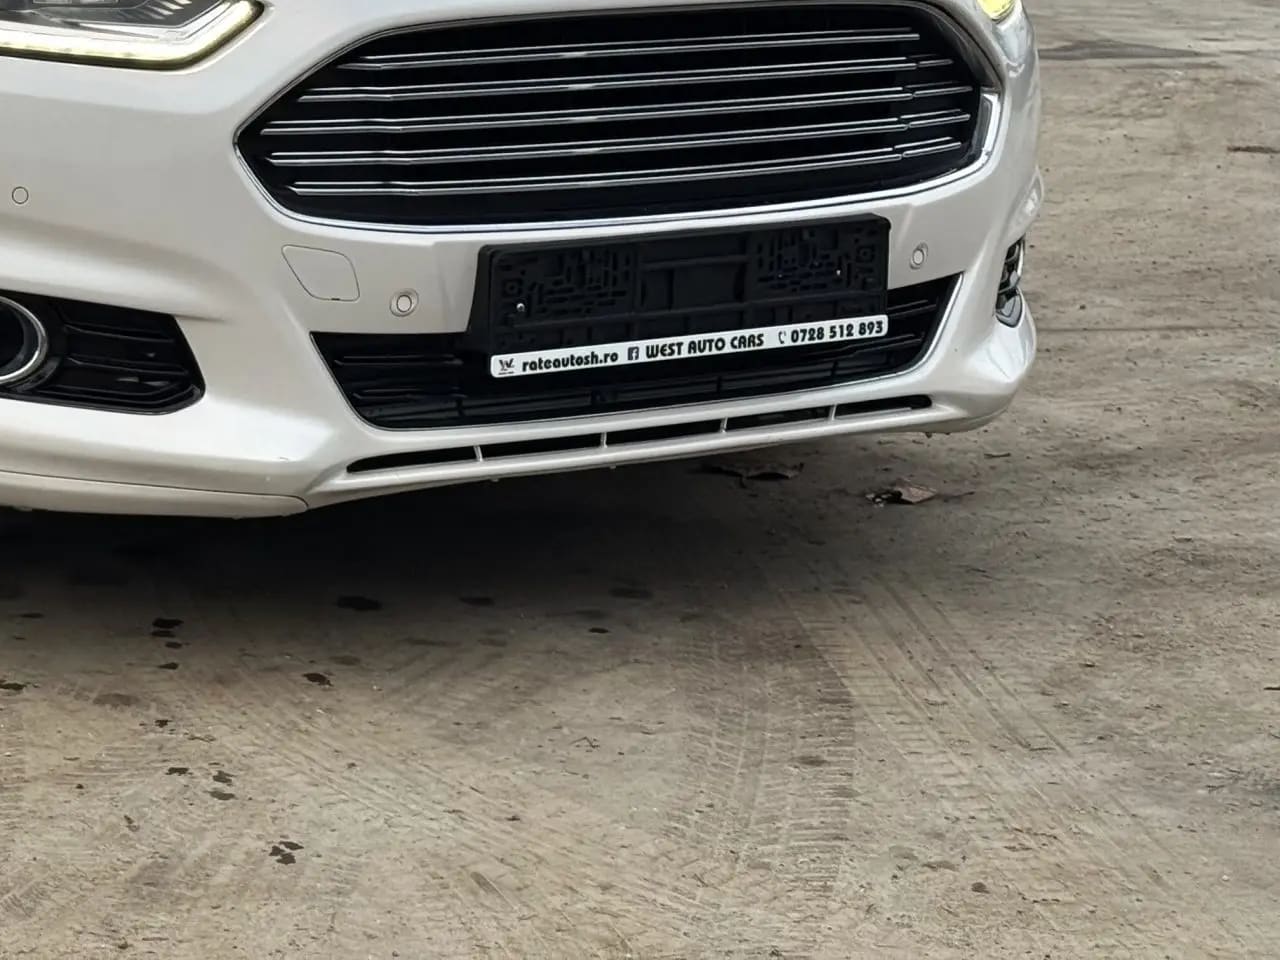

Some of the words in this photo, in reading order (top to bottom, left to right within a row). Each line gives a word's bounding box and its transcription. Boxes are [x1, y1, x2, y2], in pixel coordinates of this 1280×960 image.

[522, 351, 618, 372] rateautosh.ro
[646, 342, 683, 358] WEST
[688, 337, 726, 354] AUTO
[730, 334, 764, 349] CARS
[791, 326, 825, 344] 0728
[829, 324, 855, 340] 512
[858, 320, 884, 336] 893
